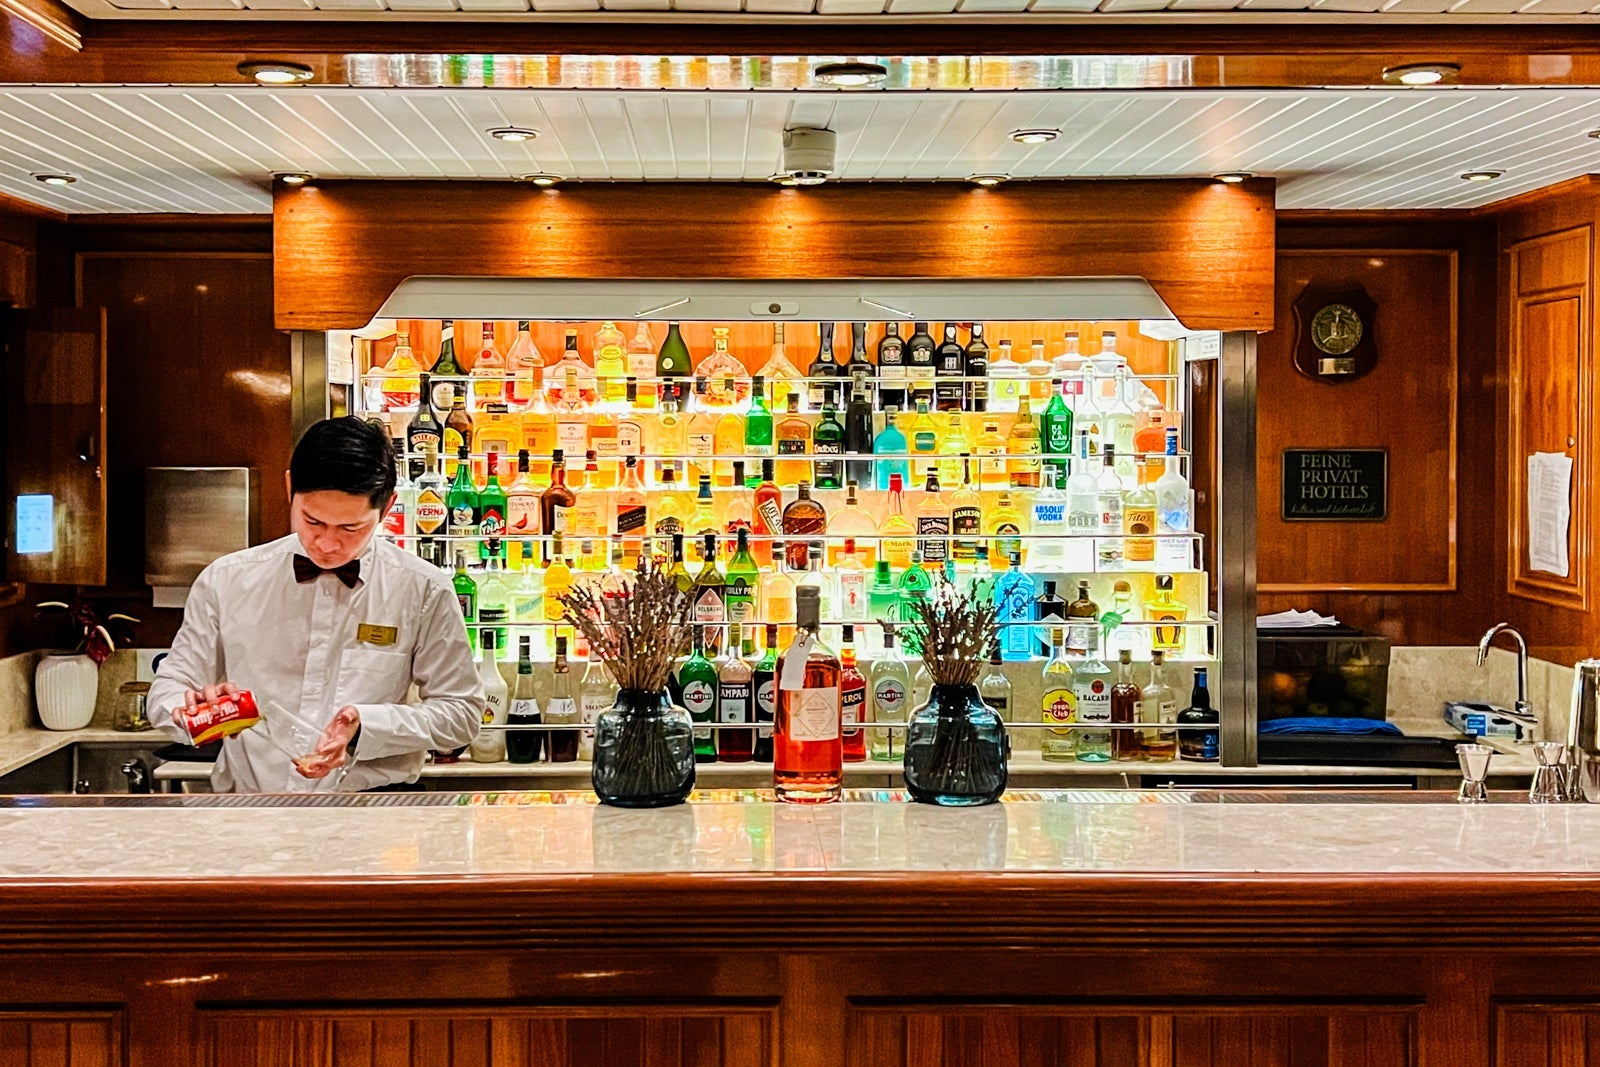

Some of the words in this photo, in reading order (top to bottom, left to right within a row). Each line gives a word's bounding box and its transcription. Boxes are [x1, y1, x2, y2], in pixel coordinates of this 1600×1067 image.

[1301, 454, 1352, 468] FEINE
[1300, 470, 1362, 483] PRIVAT
[1301, 485, 1369, 499] HOTELS
[954, 509, 981, 519] JAMESON
[1036, 505, 1065, 514] ABSOLUT
[1038, 513, 1063, 521] VODKA
[1128, 511, 1152, 522] Tito's
[721, 688, 750, 698] AMPARI
[842, 692, 862, 704] EROL
[1083, 694, 1110, 702] BACARDI
[1206, 735, 1217, 745] 20
